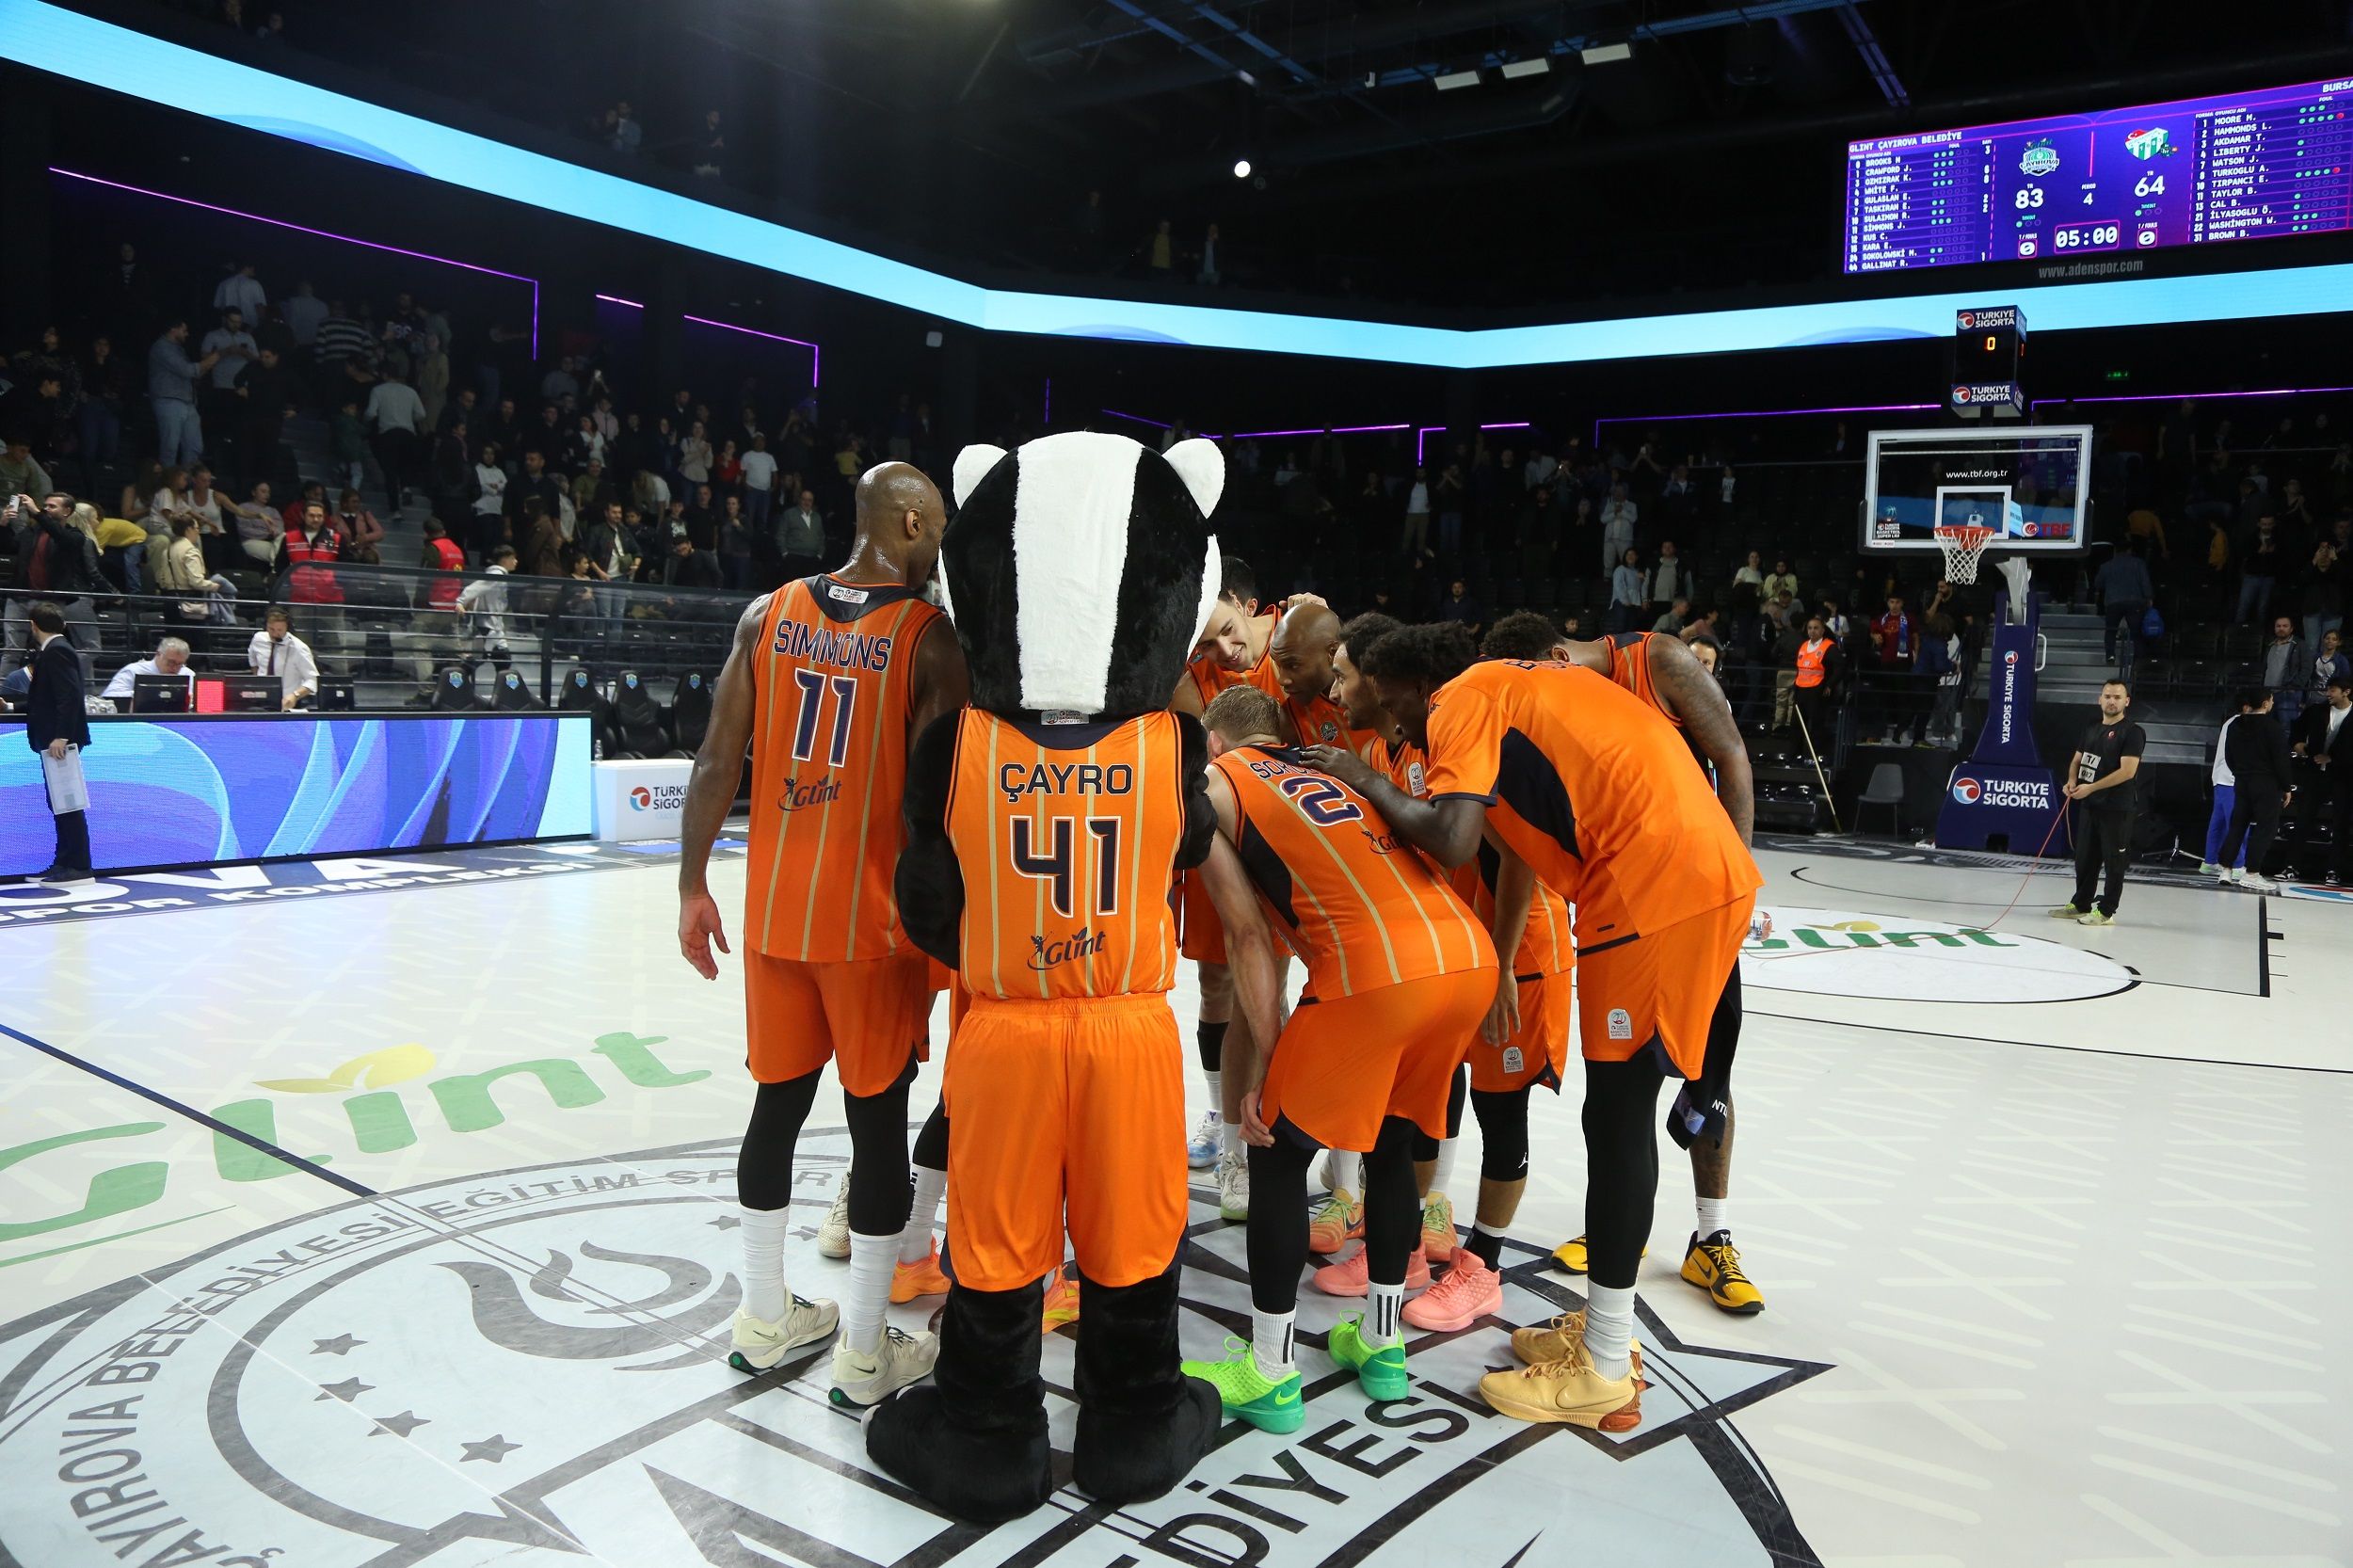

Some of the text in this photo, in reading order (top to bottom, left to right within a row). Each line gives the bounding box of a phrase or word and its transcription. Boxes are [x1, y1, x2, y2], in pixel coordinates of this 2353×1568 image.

[2202, 113, 2256, 128] 1 MOORE M.
[2202, 122, 2272, 138] 2 HAMMONDS L.
[1849, 131, 1962, 152] GLINT ÇAYIROVA BELEDİYE
[2201, 140, 2207, 149] 3
[2214, 135, 2251, 147] AKDAMAR
[1985, 146, 1991, 155] 3
[2201, 144, 2265, 159] 4 LIBERTY J.
[1865, 158, 1893, 168] BROOKS
[2201, 154, 2259, 169] 7 WATSON J.
[1865, 166, 1900, 176] CRAWFORD
[2200, 171, 2205, 180] 8
[2212, 166, 2255, 178] TURKOGLU
[1891, 184, 1898, 193] F.
[2134, 175, 2166, 198] 64
[2212, 176, 2254, 188] TIRPANCI
[2259, 175, 2268, 184] E.
[1983, 194, 1989, 203] 2
[2015, 188, 2044, 209] 83
[2083, 192, 2093, 205] 4
[2211, 187, 2243, 199] TAYLOR
[1982, 203, 1989, 213] 2
[2196, 199, 2241, 211] 13 CAL B.
[2195, 205, 2272, 222] 21 İLYASOGLU Ö.
[1897, 221, 1906, 230] J.
[2209, 216, 2263, 230] WASHİNGTON
[1863, 233, 1877, 242] KUS
[2056, 226, 2118, 248] 05:00
[2138, 232, 2155, 246] 0
[2208, 230, 2235, 241] BROWN
[1863, 242, 1881, 251] KARA
[2019, 242, 2036, 256] 0
[1900, 259, 1909, 267] R.
[2039, 260, 2144, 279] www.adenspor.com
[1987, 337, 1996, 351] 0
[1946, 469, 2008, 480] www.tbf.org.tr
[2041, 522, 2071, 536] TBF
[774, 619, 892, 673] SIMMONS
[792, 667, 858, 768] 11
[1000, 763, 1133, 804] ÇAYRO
[653, 785, 688, 797] TÜRKİ
[1279, 776, 1368, 827] 2
[1010, 815, 1122, 919] 41
[0, 898, 196, 922] POR
[1045, 927, 1106, 966] Glint
[417, 1171, 638, 1220] EĞİTİM
[663, 1167, 837, 1189] SPR
